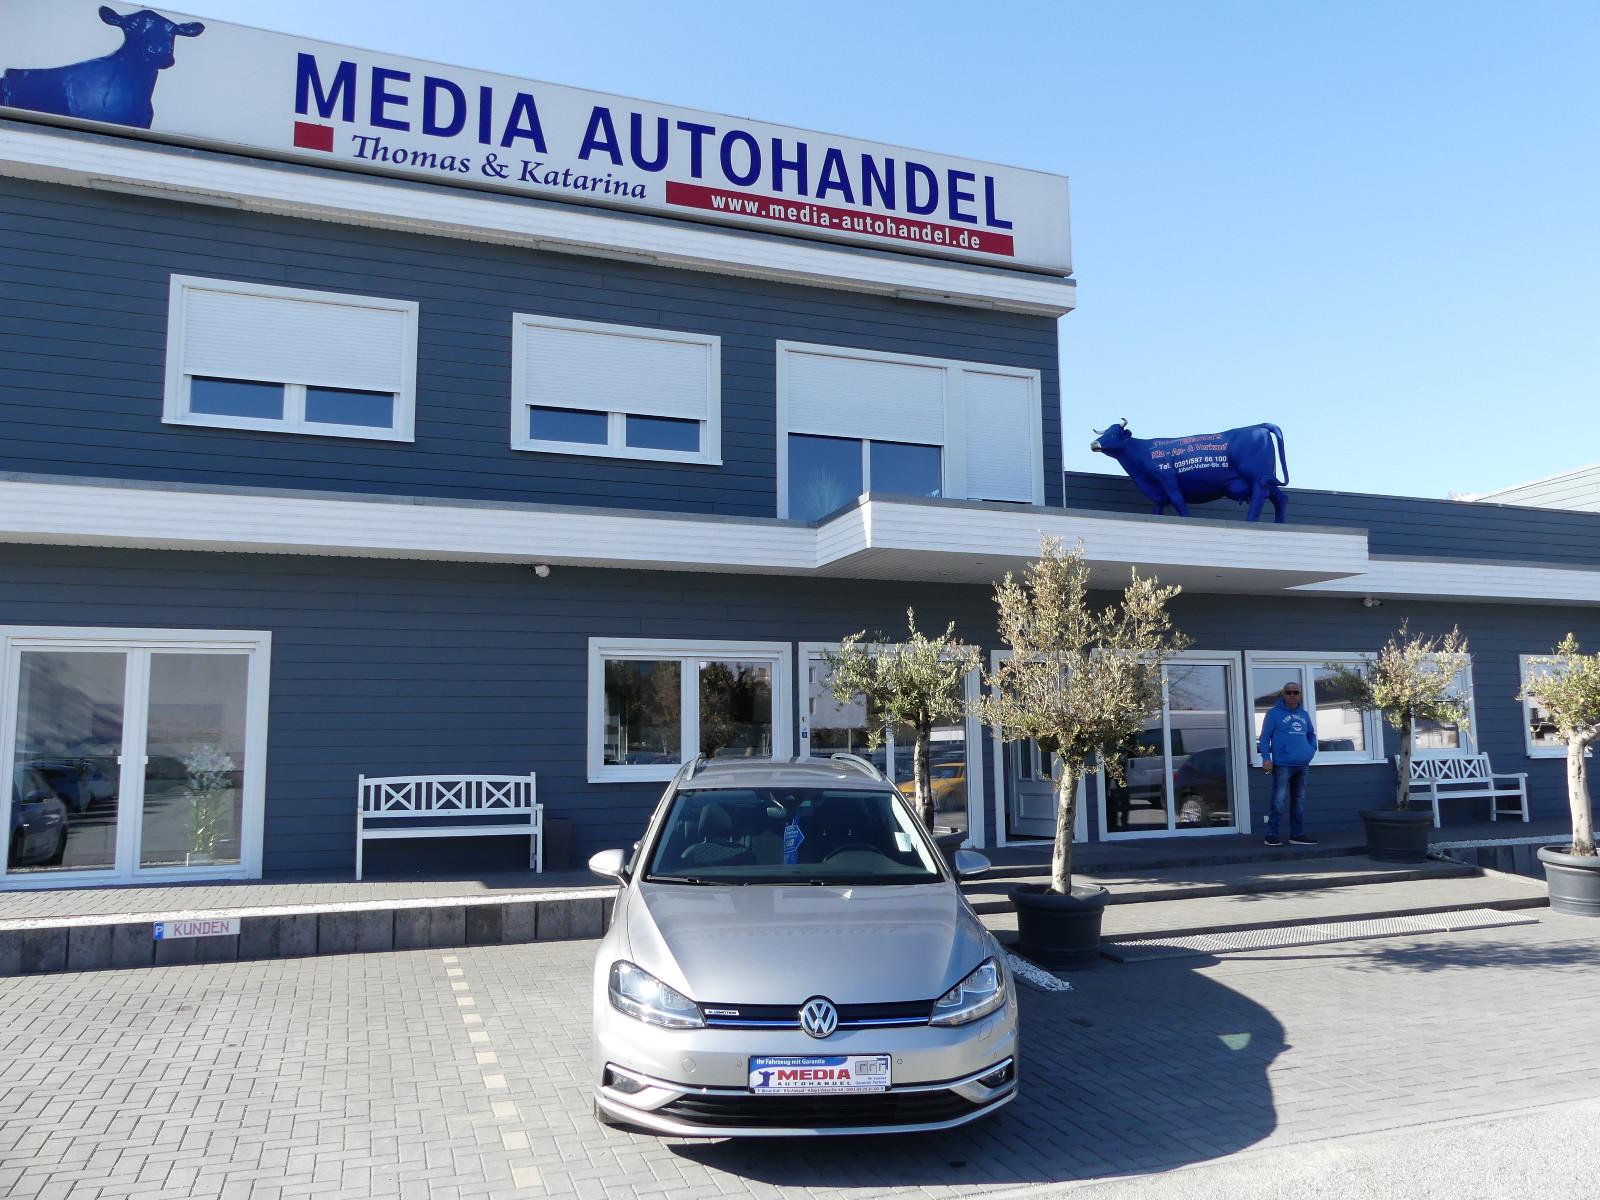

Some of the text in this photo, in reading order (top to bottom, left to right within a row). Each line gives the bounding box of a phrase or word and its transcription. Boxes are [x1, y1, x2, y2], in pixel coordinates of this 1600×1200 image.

[294, 52, 1013, 230] MEDIA AUTOHANDEL
[351, 134, 647, 200] Thomas & Katarina
[710, 194, 981, 250] www.media-autohandel.de
[155, 925, 162, 936] P
[173, 920, 230, 937] KUNDEN
[765, 1058, 791, 1066] Fahrzeug
[777, 1068, 851, 1081] MEDIA
